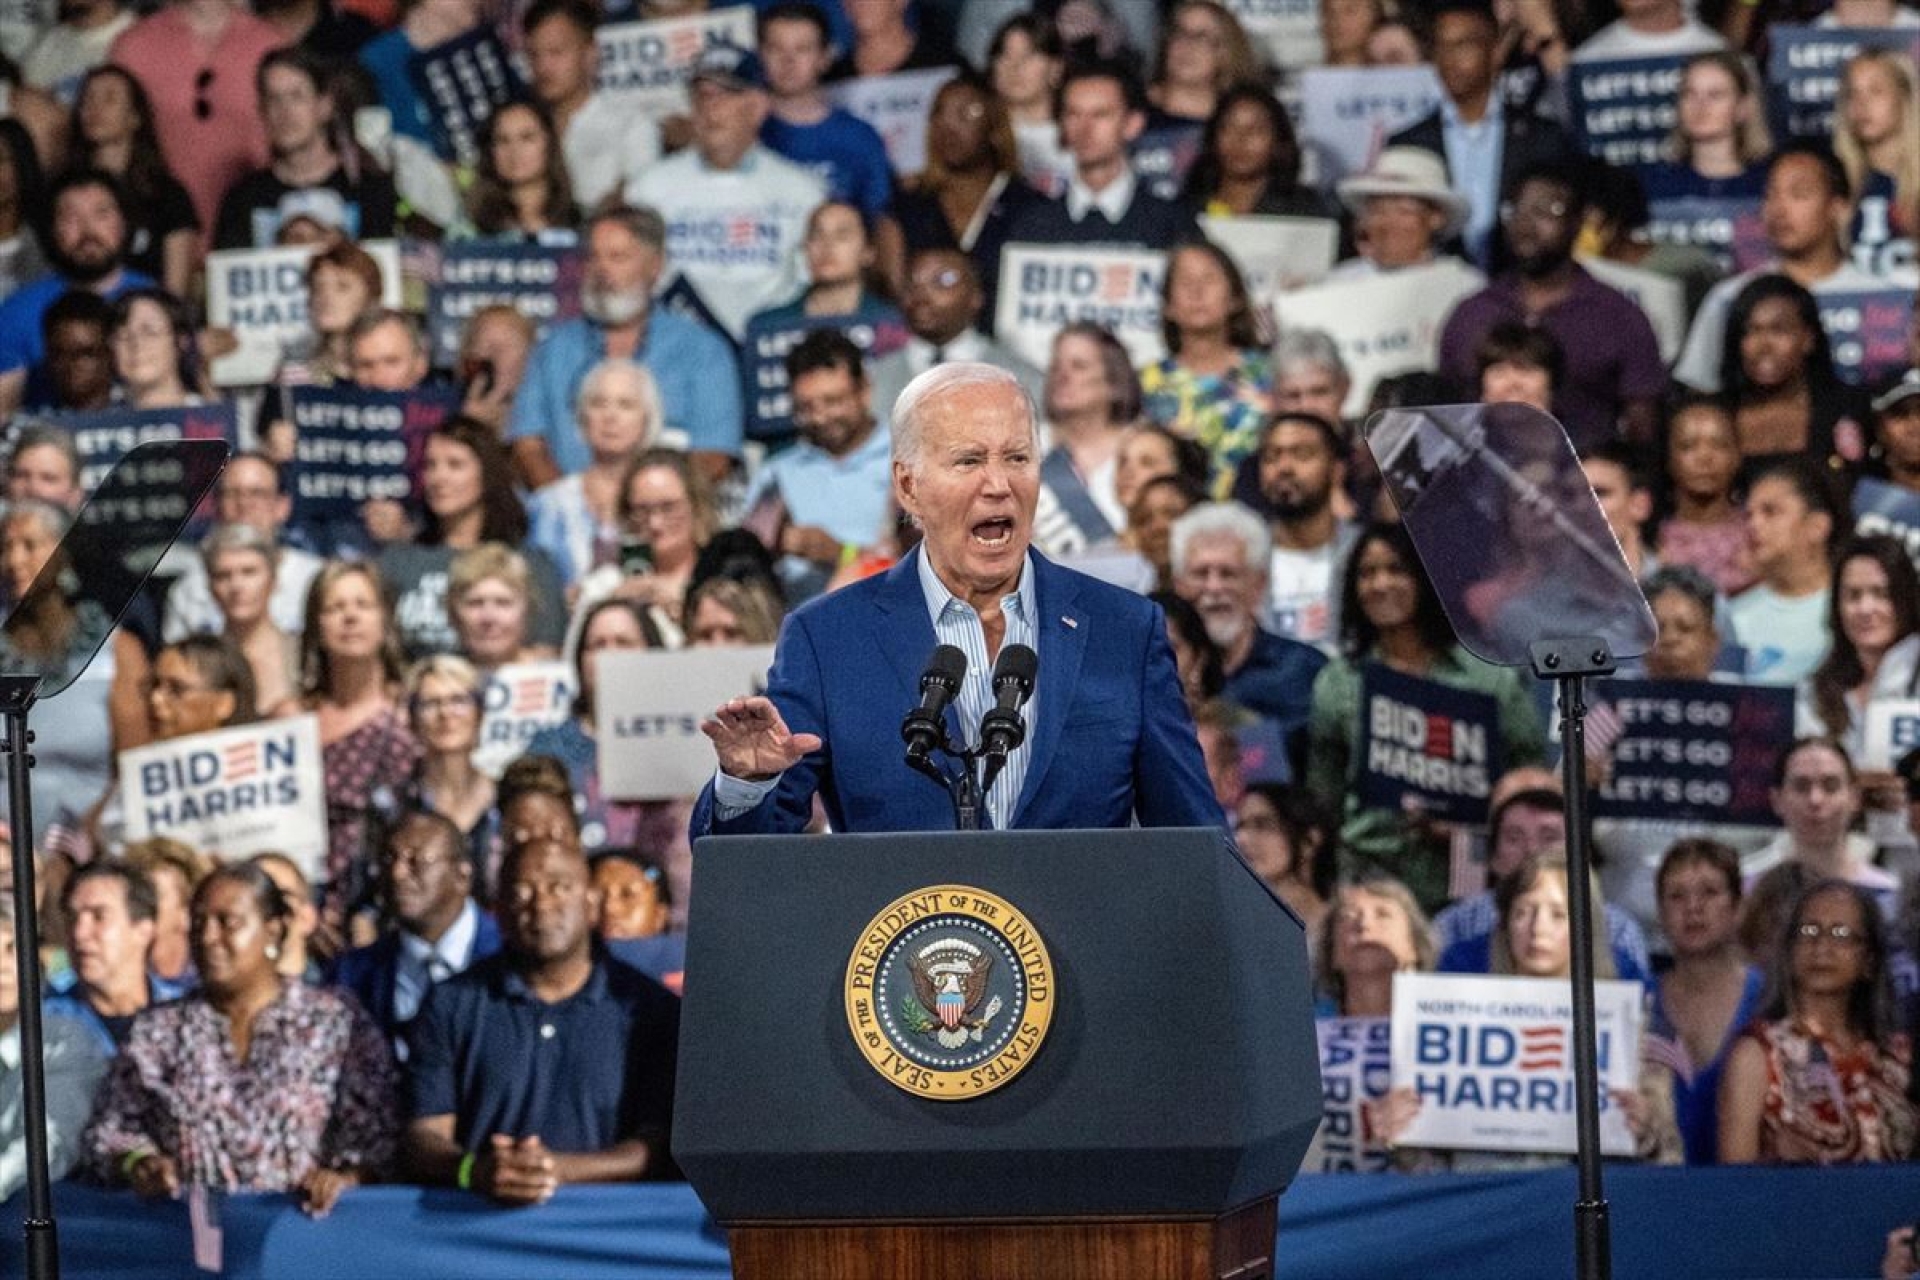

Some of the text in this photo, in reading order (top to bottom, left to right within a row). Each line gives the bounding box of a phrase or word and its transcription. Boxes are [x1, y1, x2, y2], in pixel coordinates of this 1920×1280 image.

[1582, 72, 1650, 100] LET'S
[1586, 104, 1654, 133] LET'S
[228, 264, 304, 298] BID
[442, 258, 514, 284] LET'S
[516, 258, 558, 284] GO
[295, 402, 361, 430] LET'S
[361, 405, 404, 431] GO
[75, 424, 136, 455] ET'S
[297, 436, 407, 466] LET'S GO
[299, 472, 412, 500] LET'S GO
[615, 713, 697, 738] LET'S
[1616, 699, 1682, 725] ET'S
[1685, 701, 1731, 727] GO
[1370, 694, 1488, 765] BIDEN
[140, 735, 297, 797] BIDEN
[1616, 737, 1682, 764] ET'S
[1685, 739, 1731, 766] GO
[1368, 738, 1490, 798] HARRIS
[145, 774, 300, 832] HARRIS
[1685, 778, 1731, 806] GO
[852, 893, 1048, 1090] SEAL OF THE PRESIDENT OF THE UNITED STATES
[1485, 1001, 1572, 1020] CAROLIN
